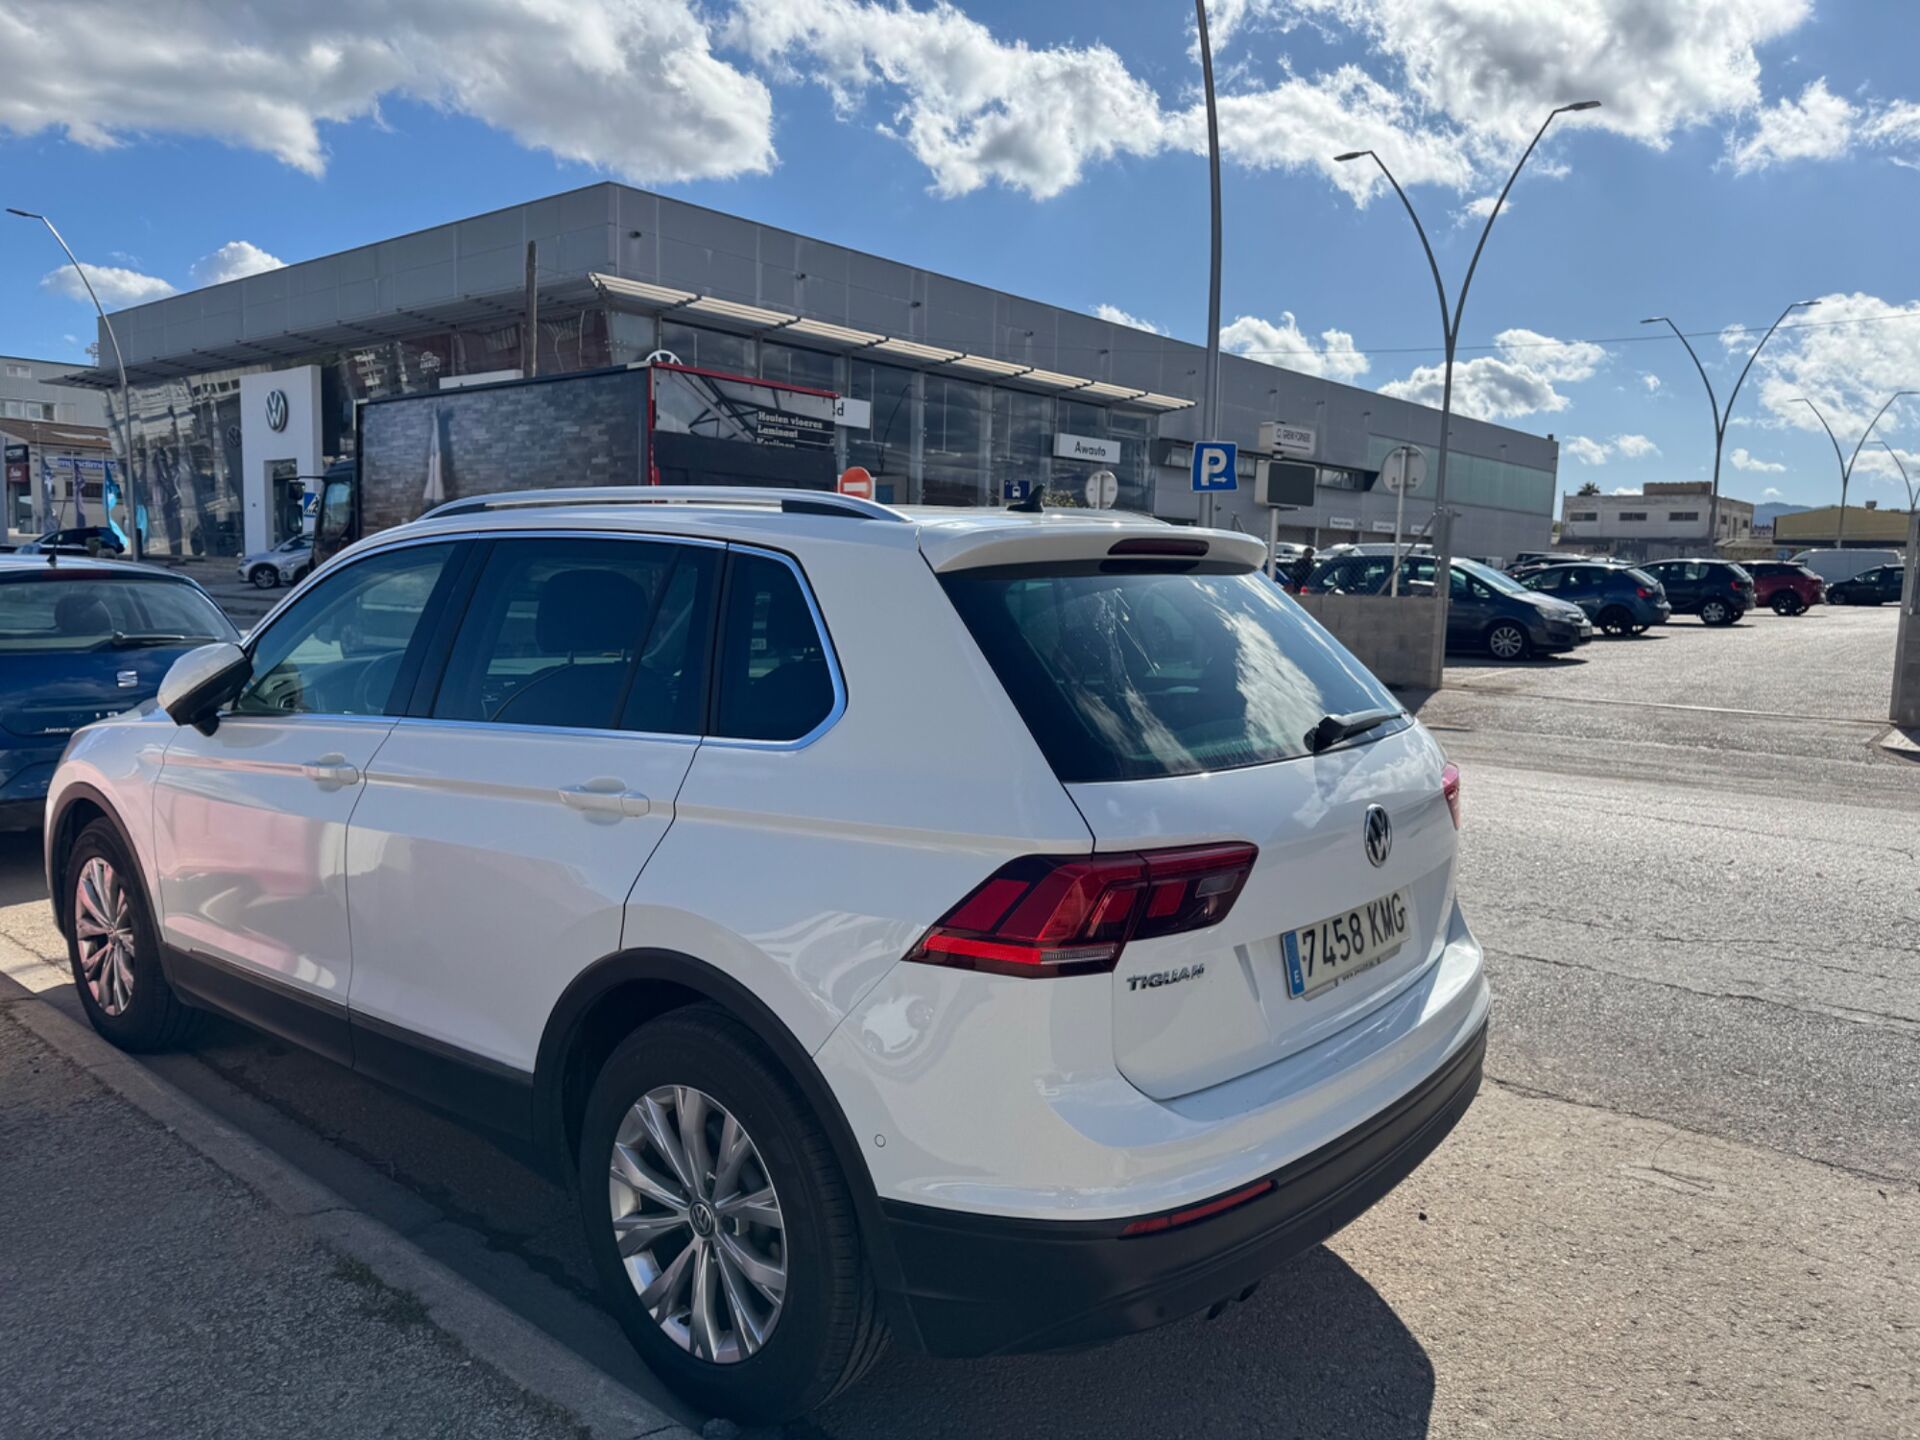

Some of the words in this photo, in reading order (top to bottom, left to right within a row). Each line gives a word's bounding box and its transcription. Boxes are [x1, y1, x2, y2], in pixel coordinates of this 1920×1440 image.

[757, 424, 799, 439] Laminaat
[1200, 447, 1228, 487] P
[1302, 911, 1364, 978] 7458
[1366, 892, 1406, 947] KMG
[1126, 963, 1205, 992] TIGUAN
